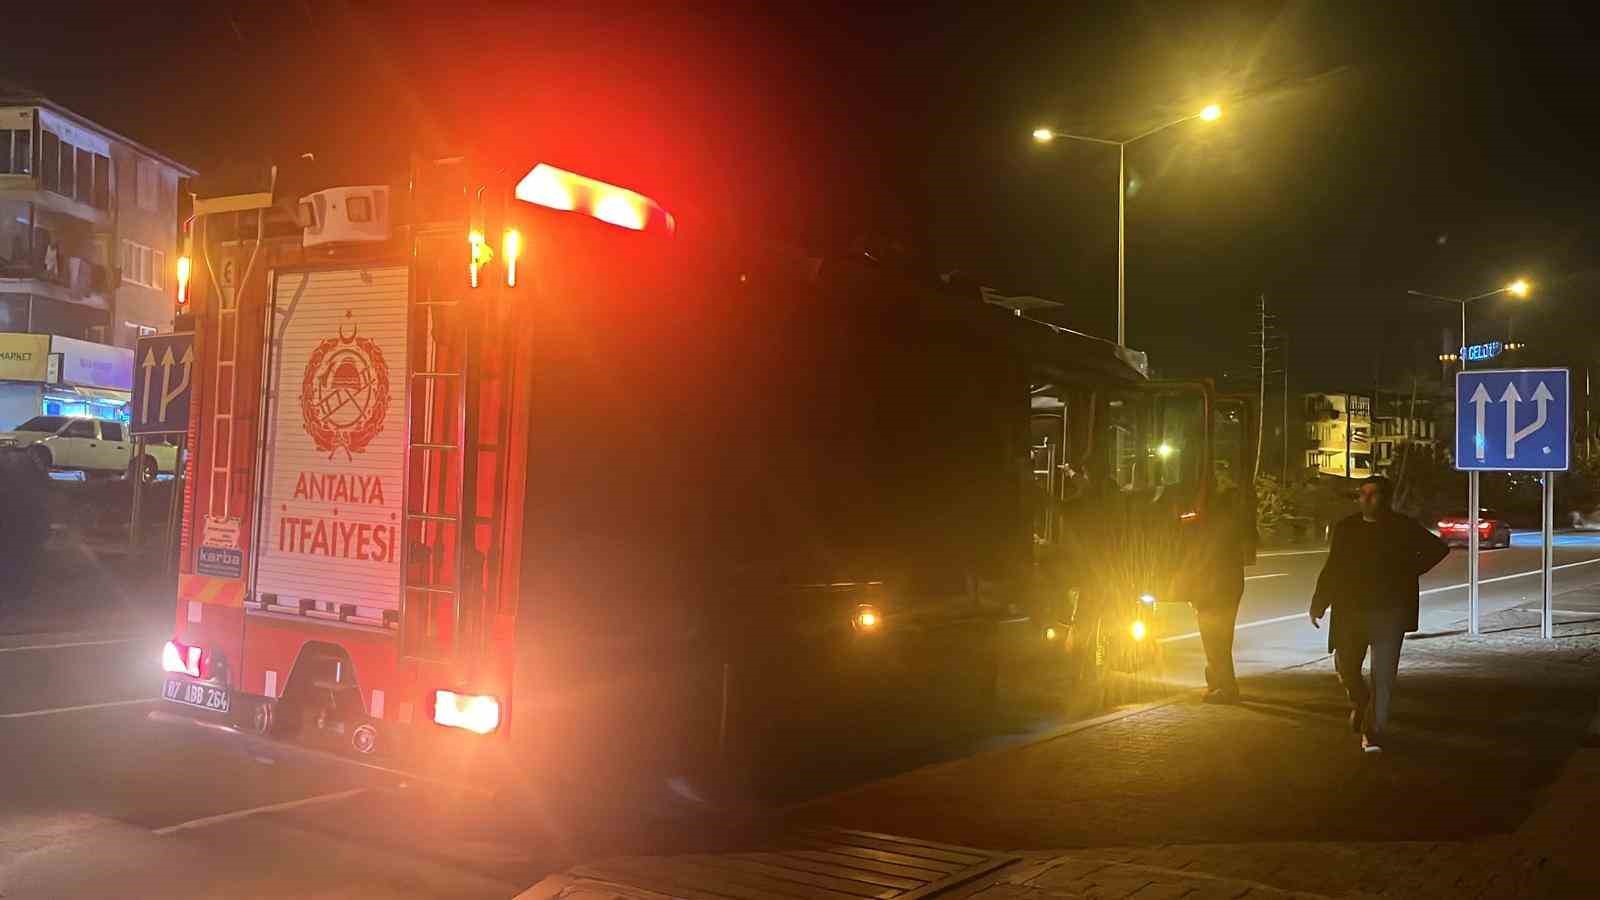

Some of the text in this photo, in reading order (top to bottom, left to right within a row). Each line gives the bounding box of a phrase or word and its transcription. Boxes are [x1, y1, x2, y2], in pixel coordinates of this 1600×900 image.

[293, 471, 384, 506] ANTALYA
[279, 503, 396, 563] İTFAİYESİ
[206, 688, 227, 710] 264
